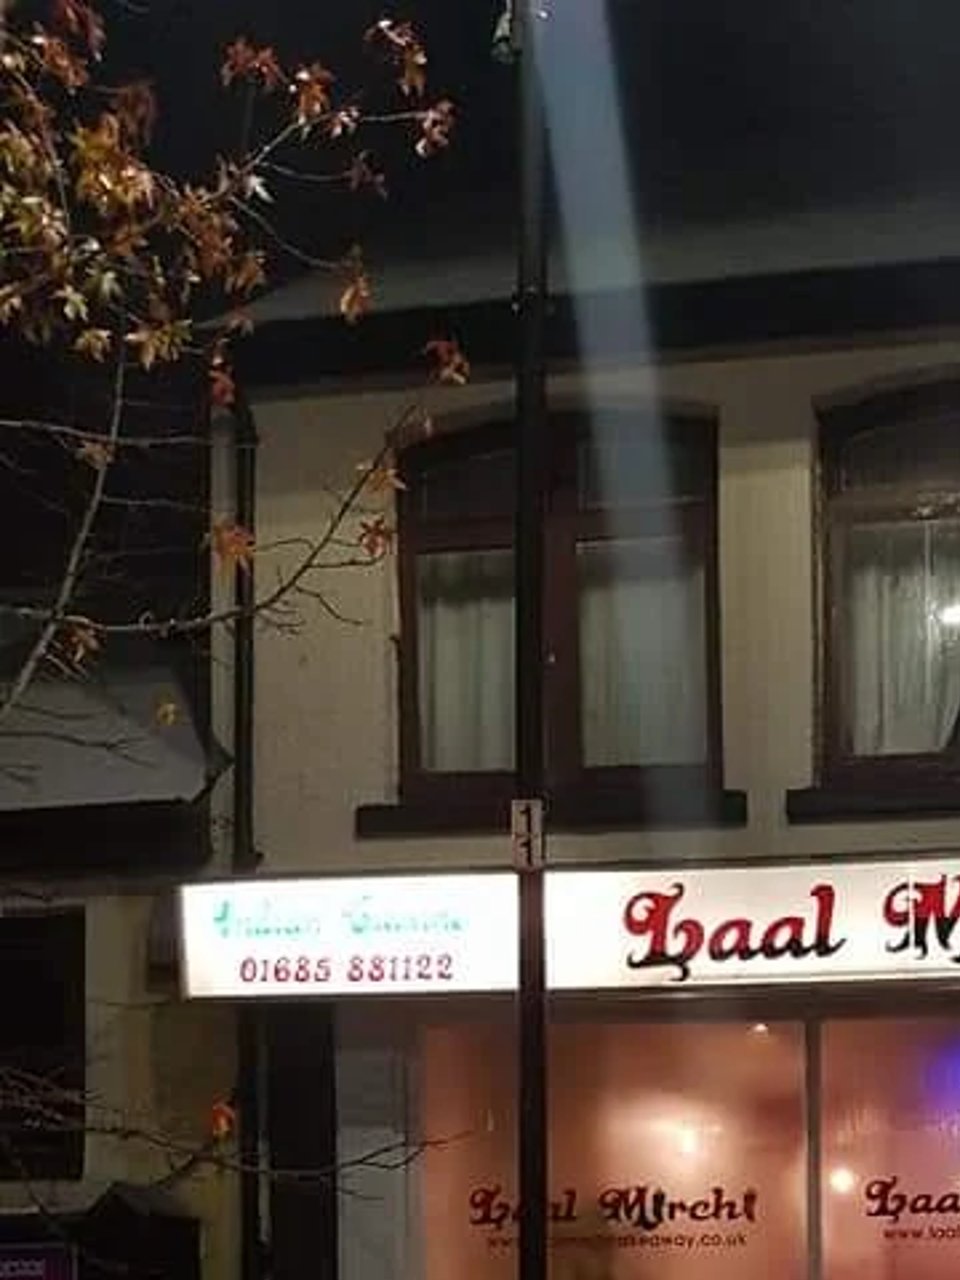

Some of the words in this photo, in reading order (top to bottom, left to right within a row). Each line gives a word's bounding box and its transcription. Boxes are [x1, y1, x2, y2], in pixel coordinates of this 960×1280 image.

[624, 882, 847, 981] Laal
[239, 957, 331, 983] 01685
[347, 954, 454, 983] 881122
